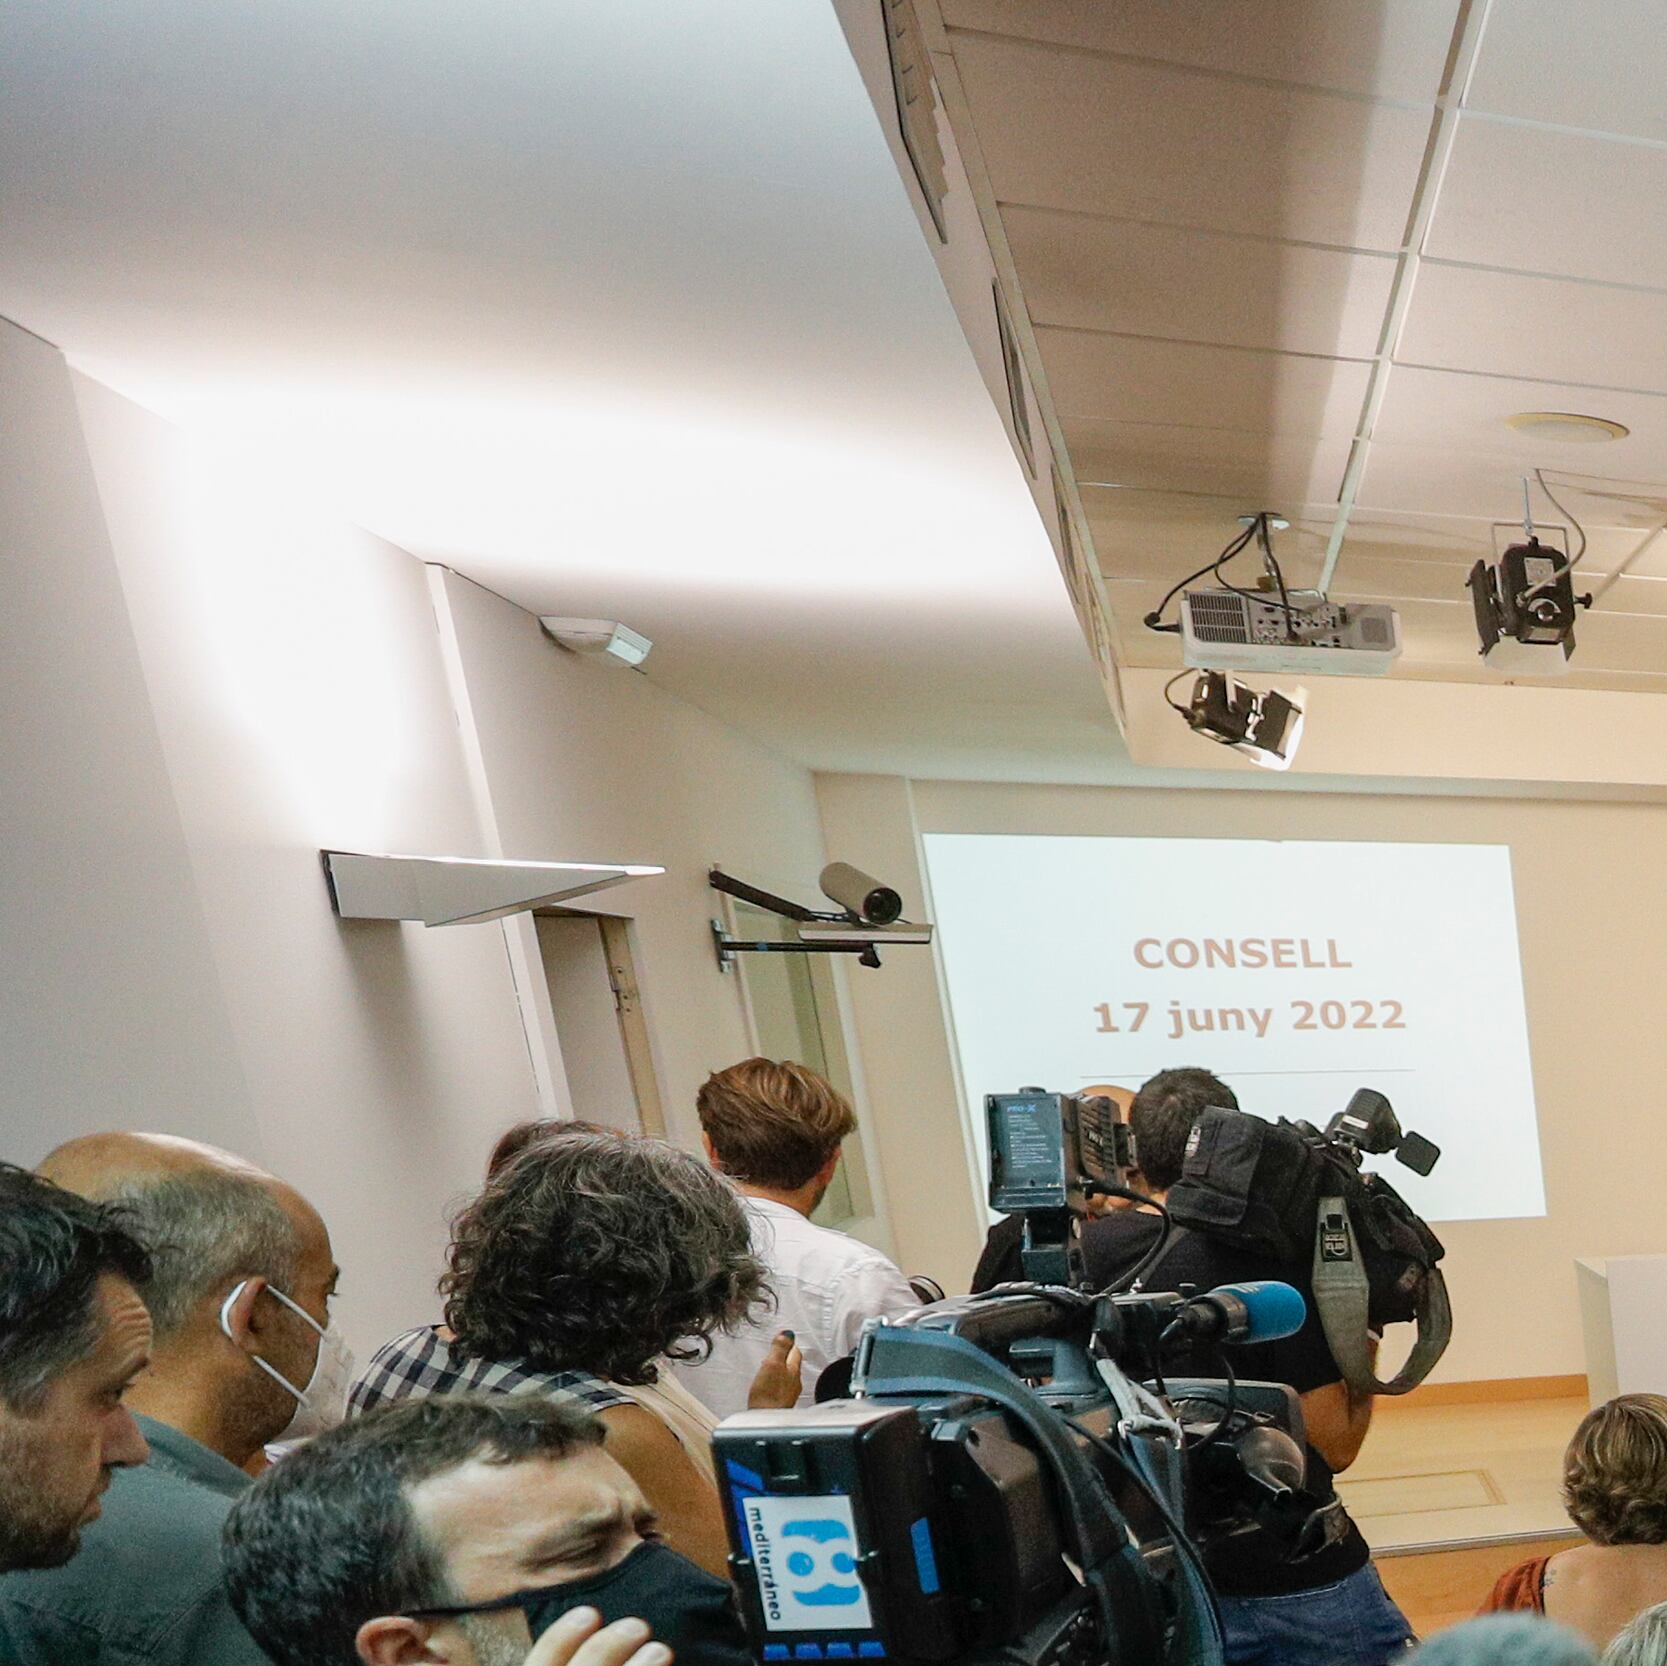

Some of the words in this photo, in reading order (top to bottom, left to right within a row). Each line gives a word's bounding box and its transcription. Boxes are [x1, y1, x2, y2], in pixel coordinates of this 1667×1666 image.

[1133, 937, 1353, 969] CONSELL
[1093, 1002, 1150, 1033] 17
[1167, 1000, 1273, 1039] juny
[1290, 1000, 1406, 1030] 2022
[749, 1506, 782, 1621] mediterráneo
